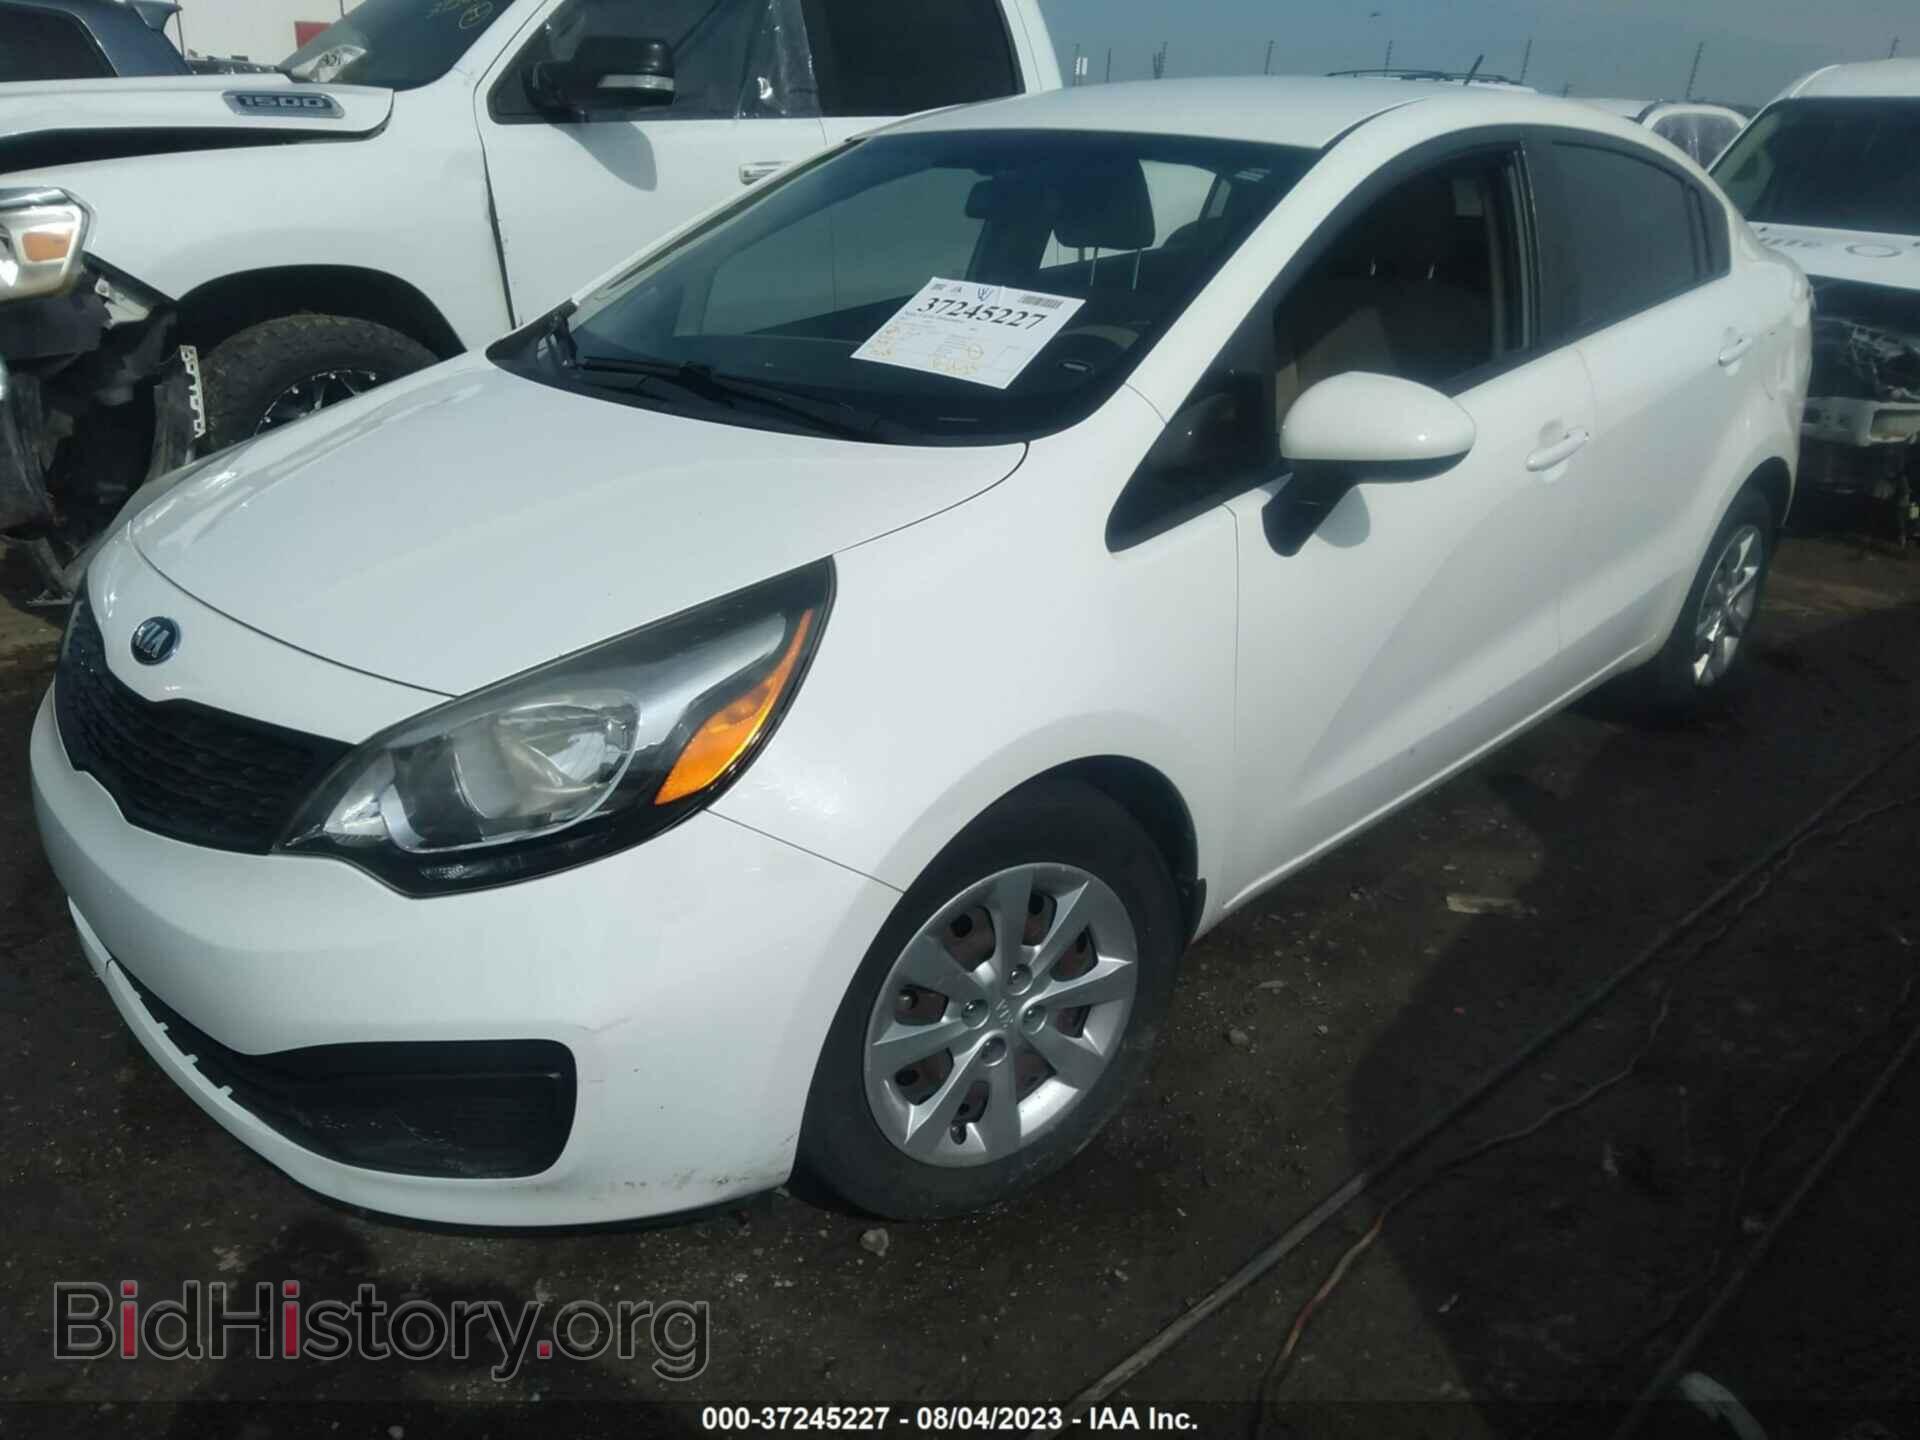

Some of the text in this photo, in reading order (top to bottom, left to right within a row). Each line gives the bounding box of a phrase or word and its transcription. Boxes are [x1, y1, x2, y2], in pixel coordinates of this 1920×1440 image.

[239, 95, 325, 109] 1500
[918, 298, 1047, 330] 37245227
[133, 621, 173, 660] KIA
